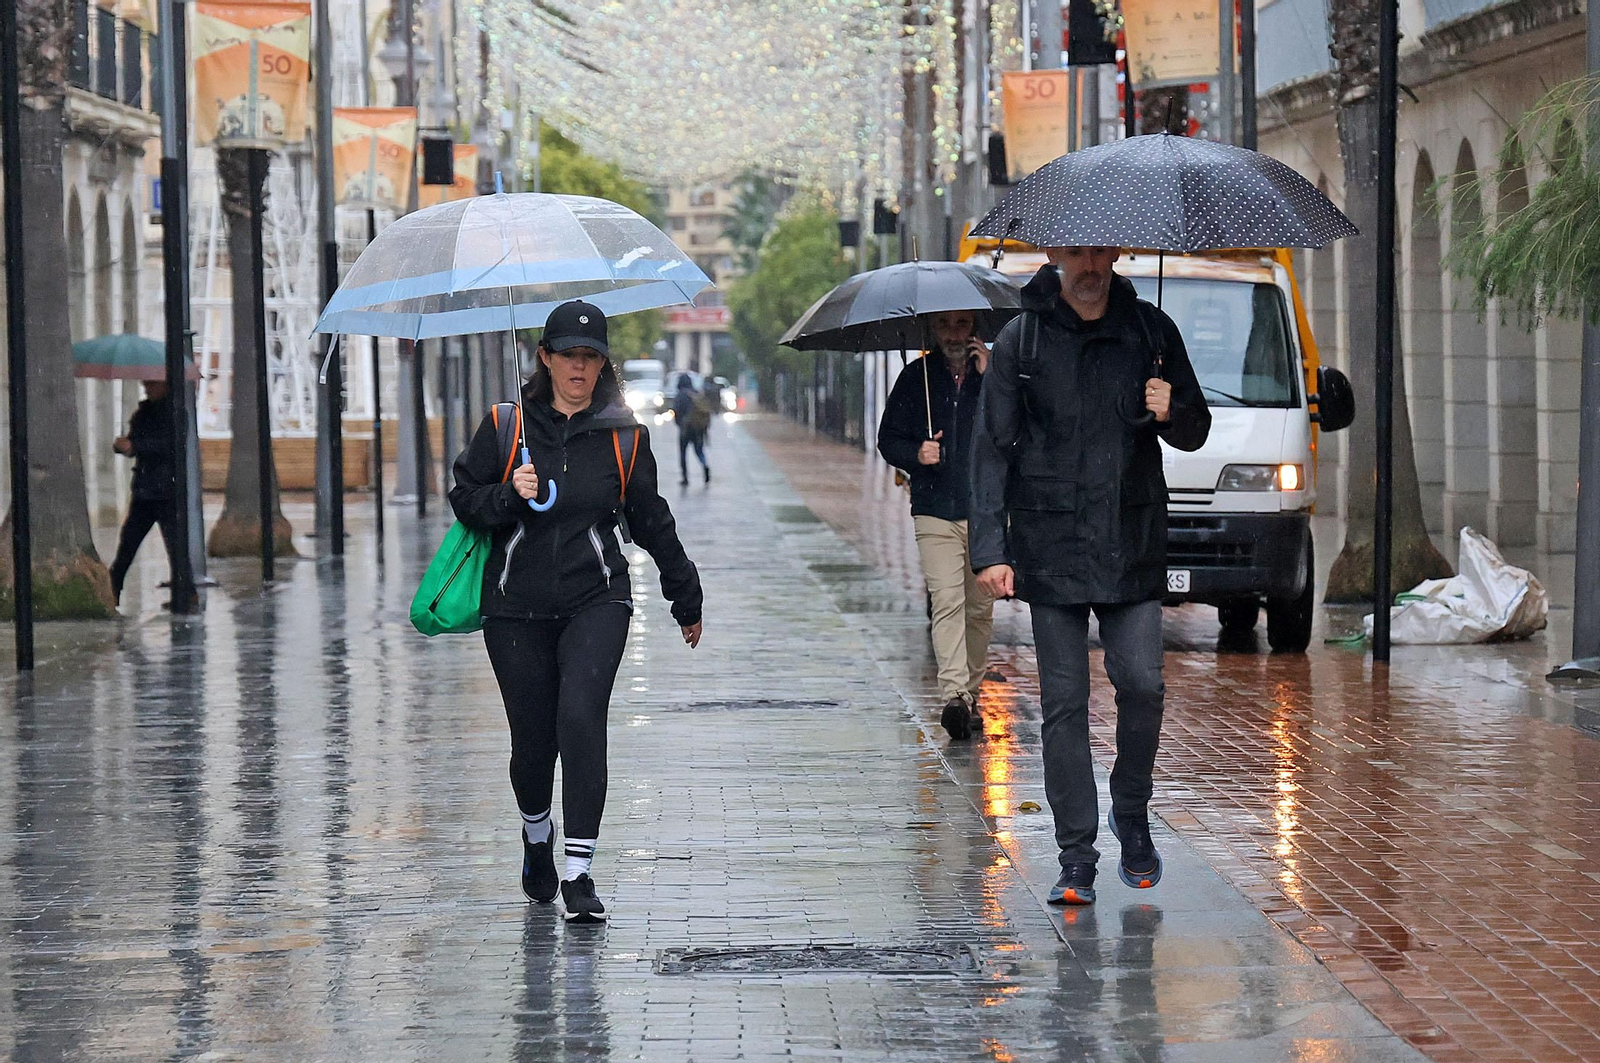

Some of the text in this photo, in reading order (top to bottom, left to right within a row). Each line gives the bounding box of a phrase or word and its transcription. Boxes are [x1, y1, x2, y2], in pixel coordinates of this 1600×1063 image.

[262, 54, 292, 75] 50
[1024, 78, 1056, 101] 50
[379, 143, 399, 158] 50
